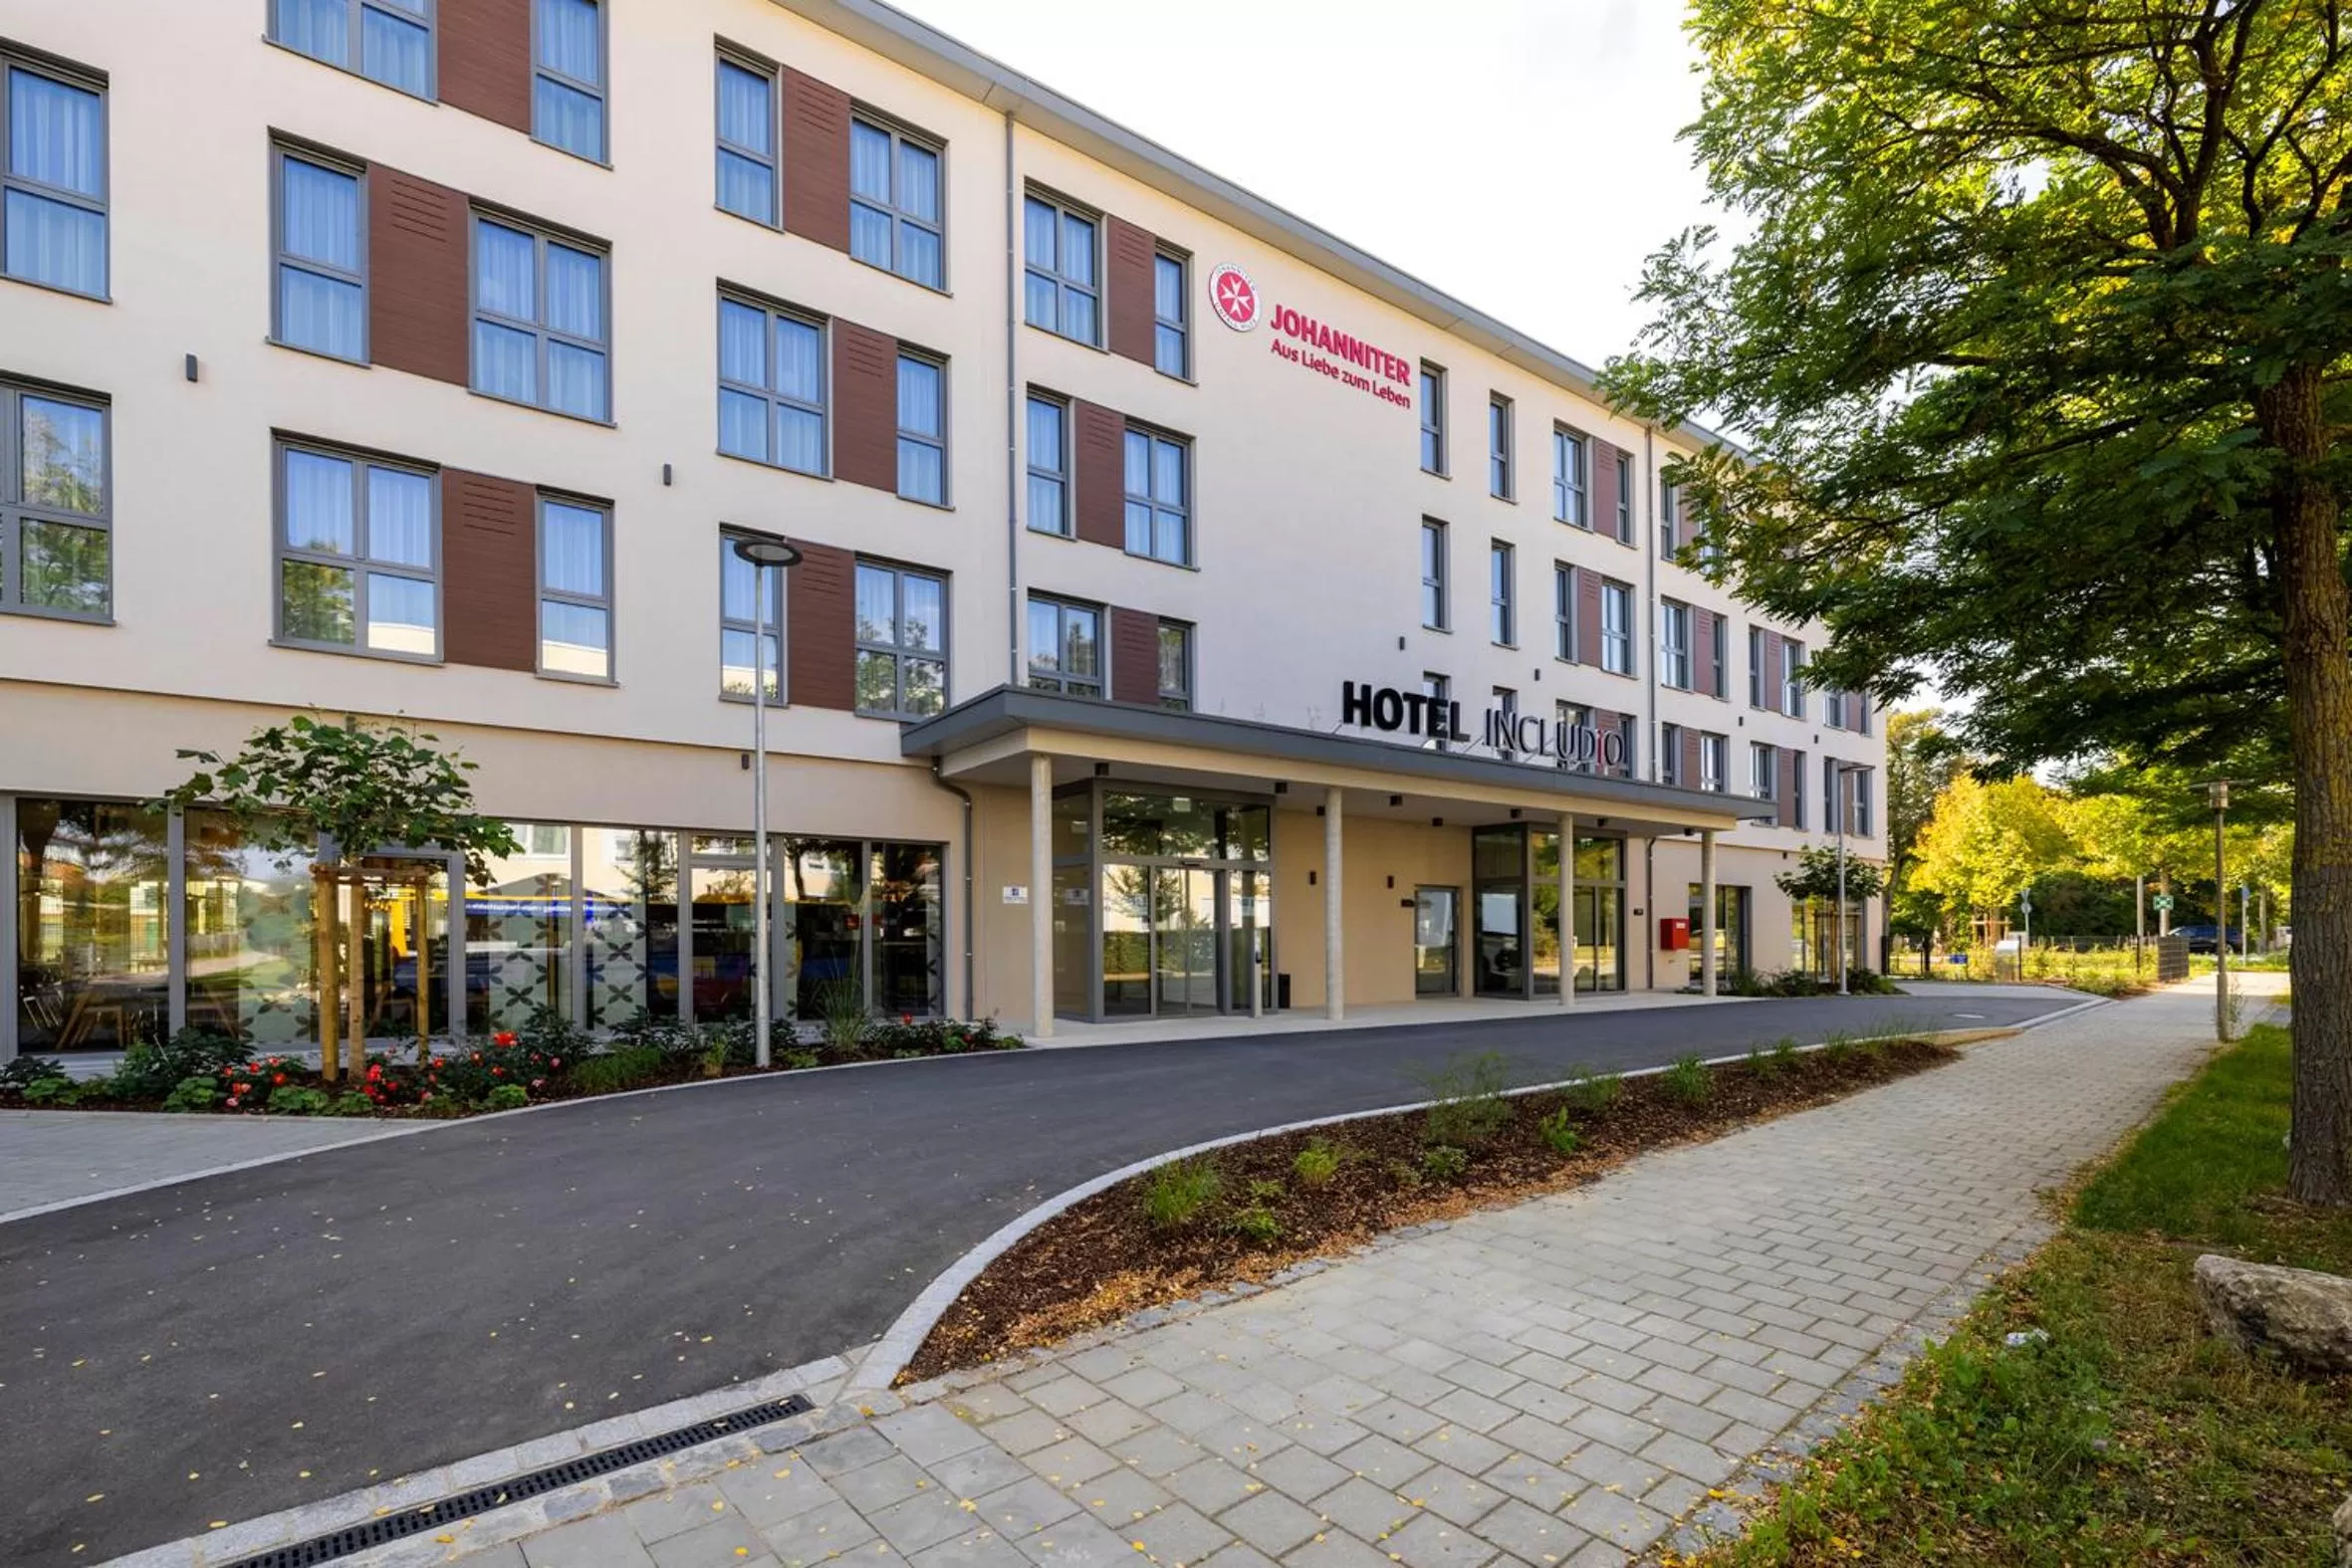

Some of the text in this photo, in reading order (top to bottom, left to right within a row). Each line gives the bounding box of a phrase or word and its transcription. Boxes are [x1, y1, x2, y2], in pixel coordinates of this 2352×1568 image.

[1271, 304, 1411, 387] JOHANNITER
[1271, 338, 1411, 409] Aus Liebe zum Leben
[1343, 681, 1470, 742] HOTEL
